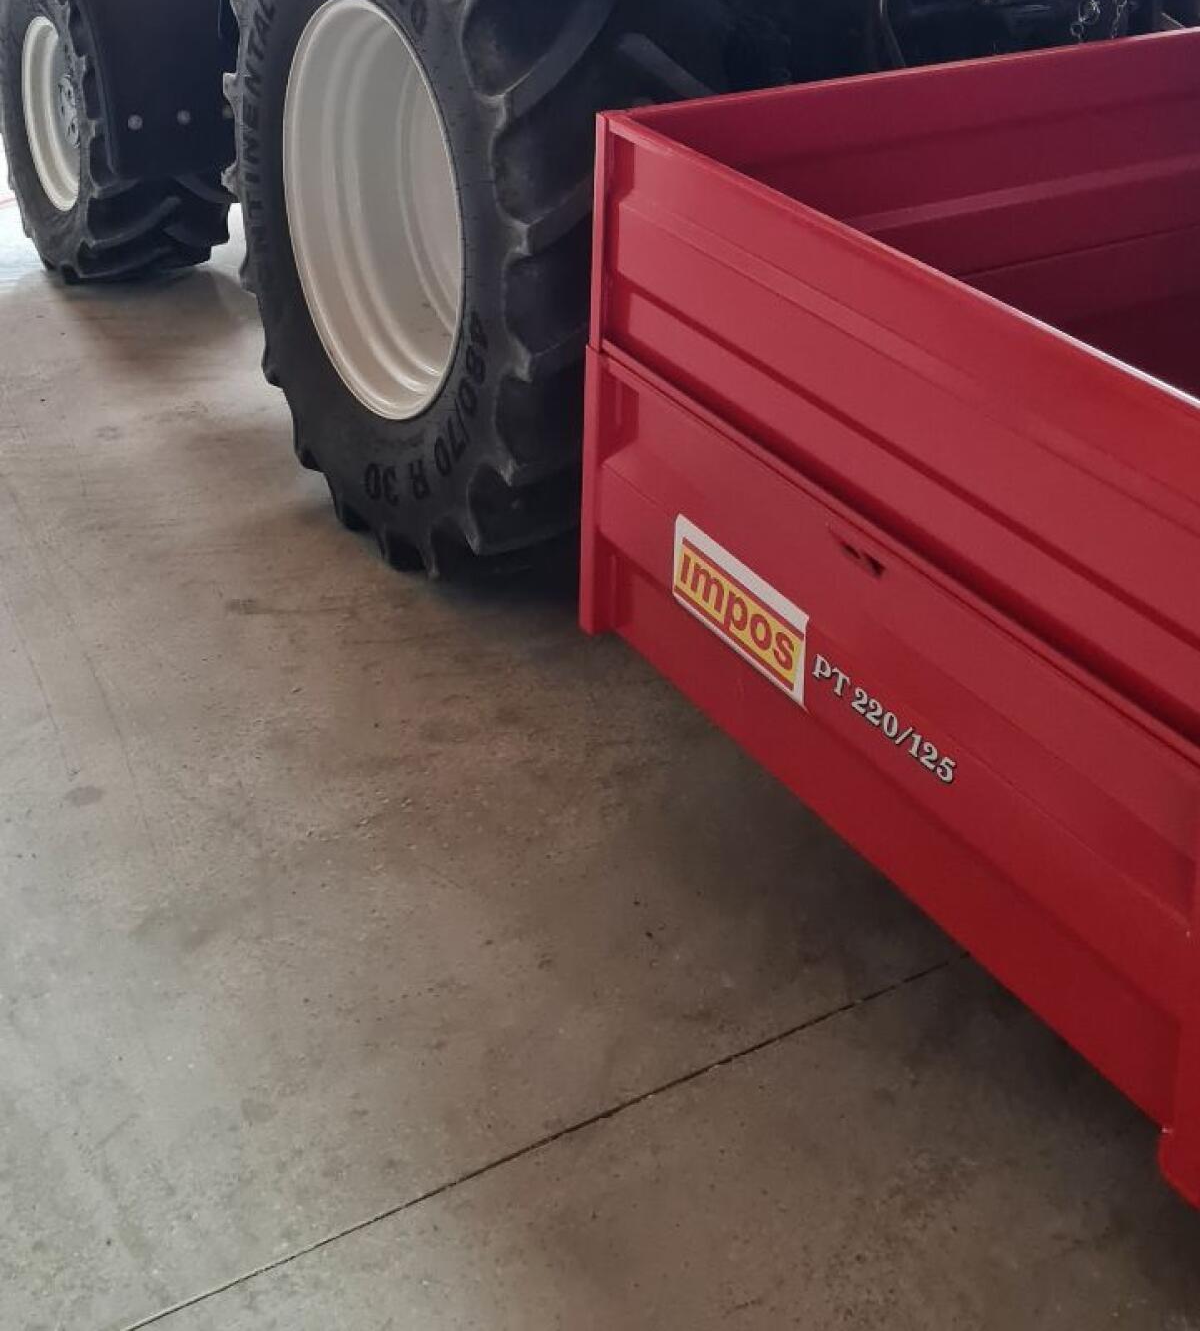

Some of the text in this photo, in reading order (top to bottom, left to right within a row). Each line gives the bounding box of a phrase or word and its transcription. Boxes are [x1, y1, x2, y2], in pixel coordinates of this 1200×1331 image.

[364, 310, 489, 507] 480/70 R 30
[680, 552, 795, 671] impos
[812, 653, 957, 784] PT 220/125
